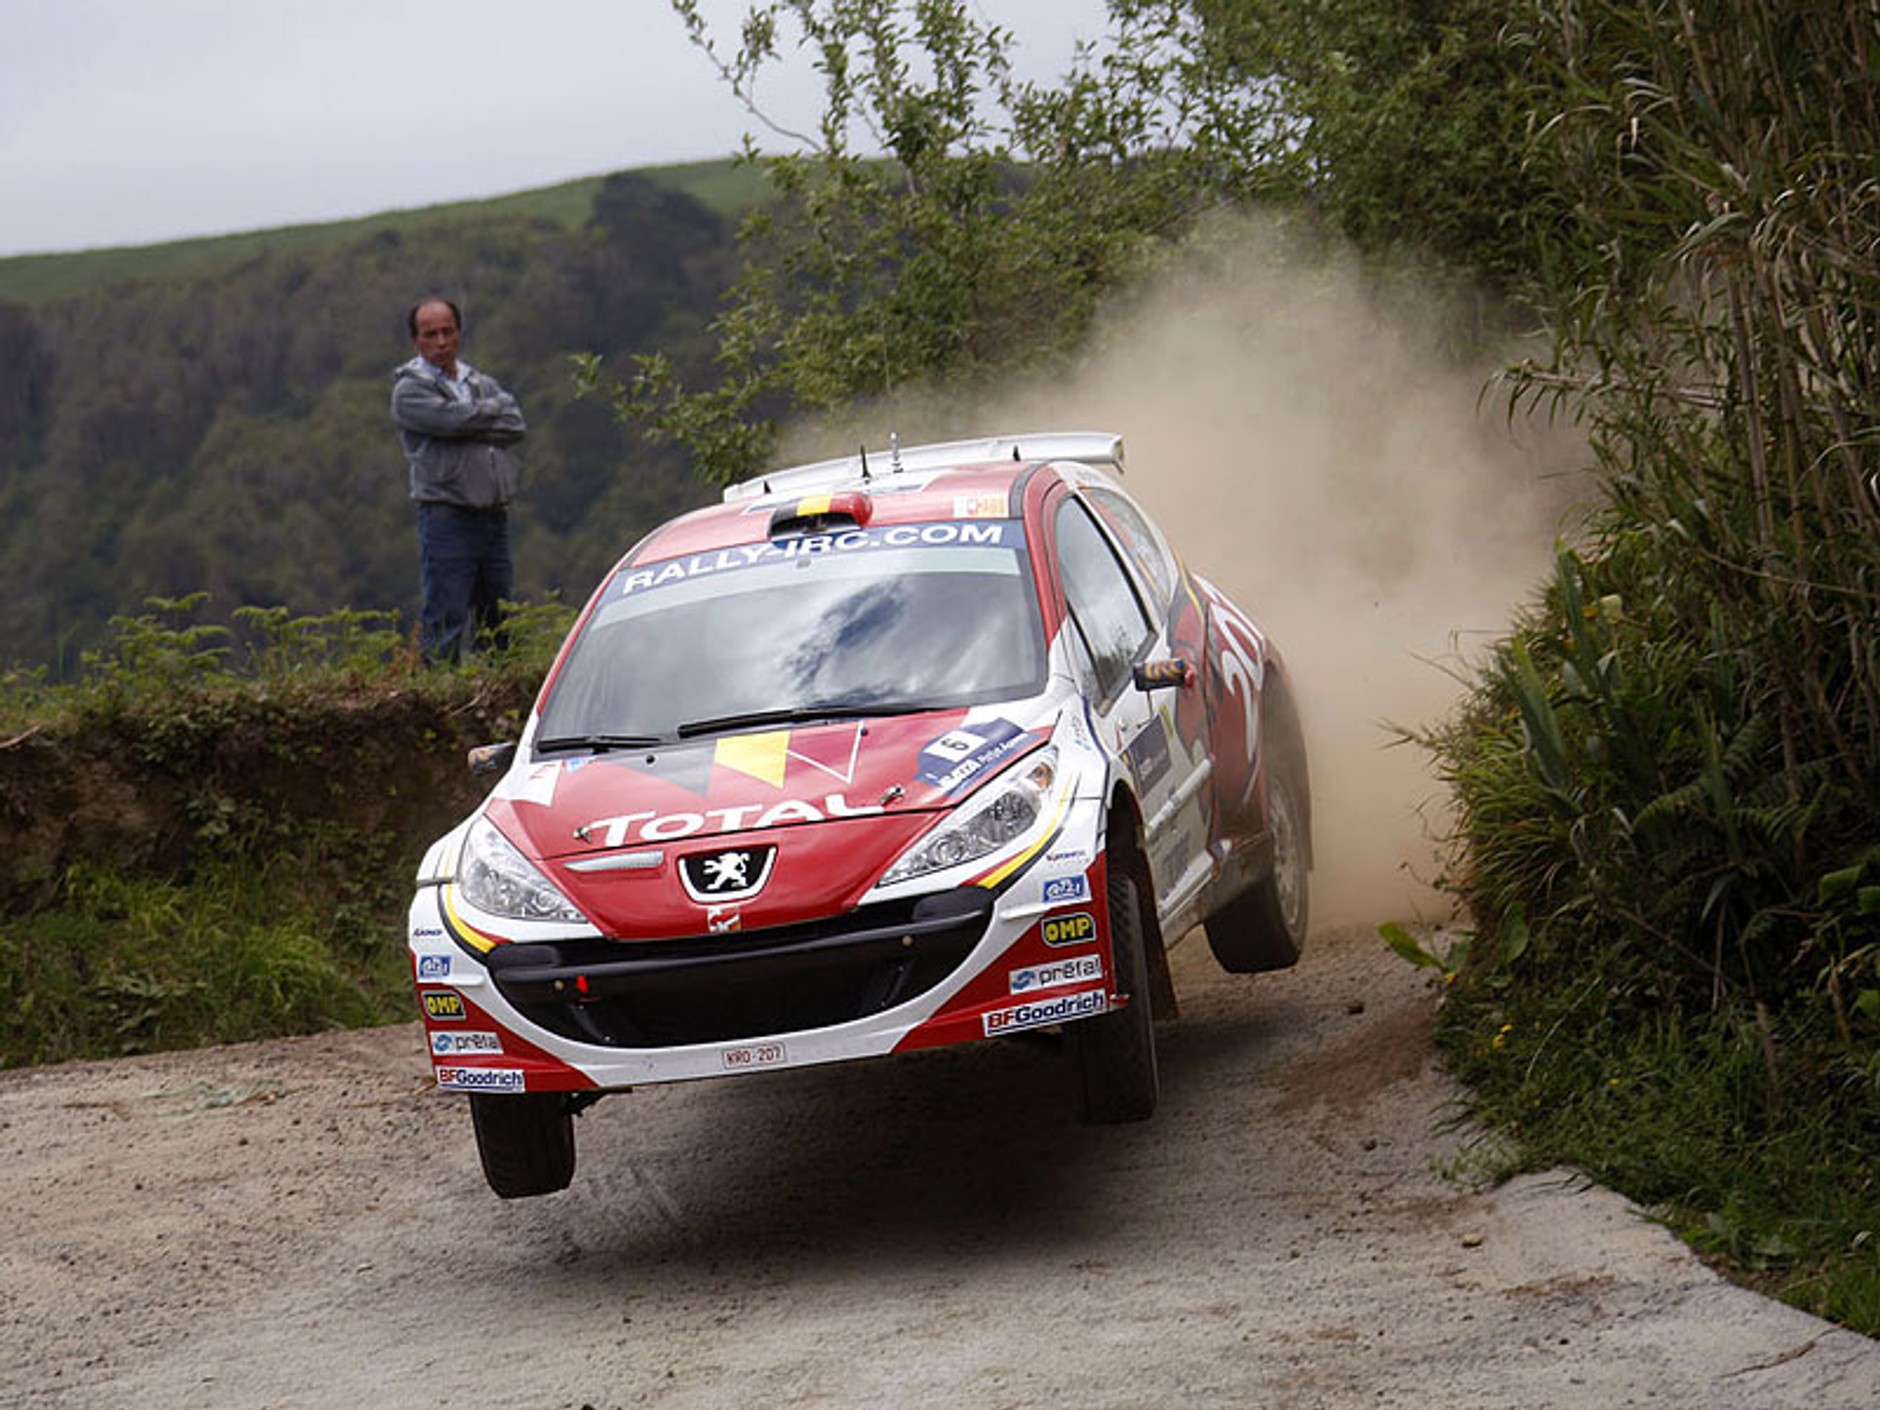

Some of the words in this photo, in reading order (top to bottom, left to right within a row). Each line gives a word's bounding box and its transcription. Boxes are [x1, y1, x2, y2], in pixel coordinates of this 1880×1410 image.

[622, 523, 1003, 594] RALLY-IRC.COM
[592, 794, 885, 847] TOTAL
[1045, 917, 1090, 941] OMP
[426, 995, 460, 1014] OMP
[988, 991, 1104, 1029] BFGoodrich
[439, 1069, 523, 1085] BFGoodrich
